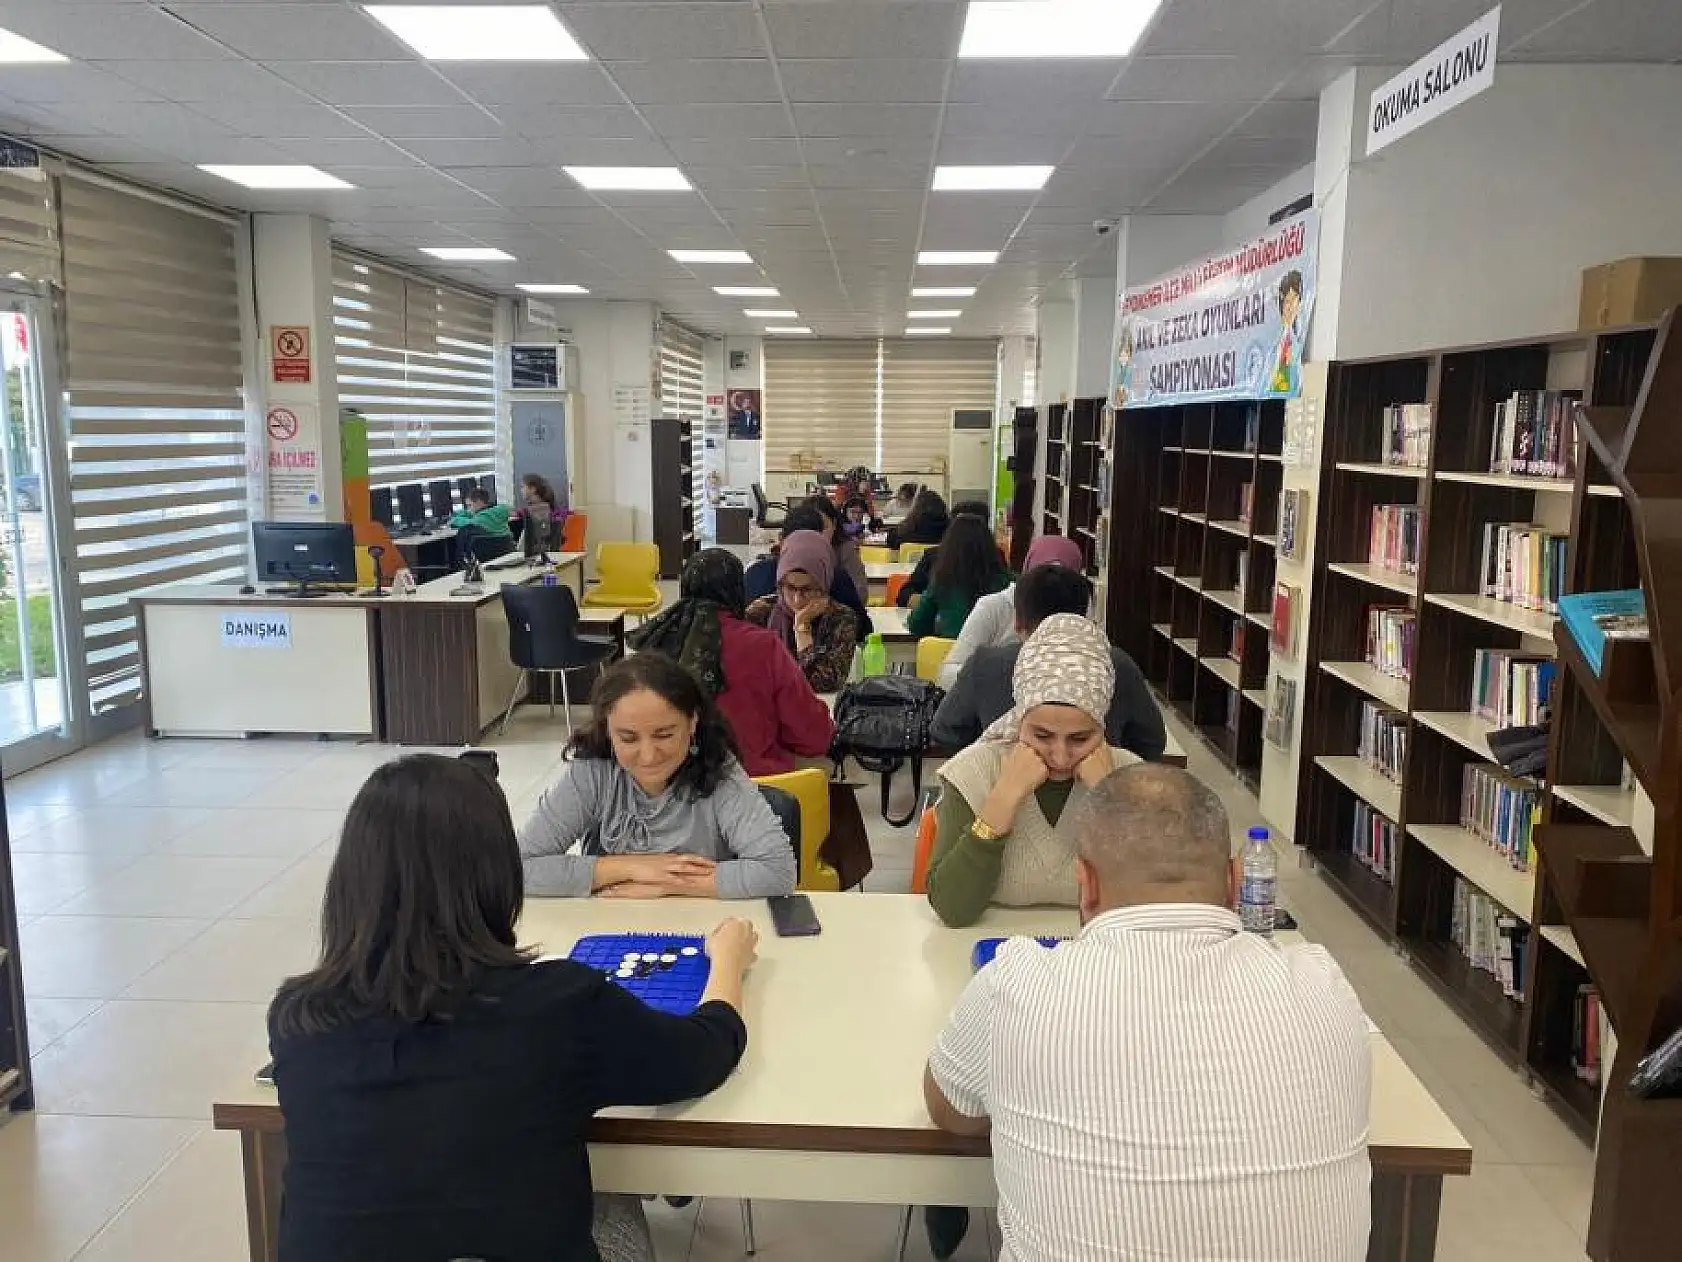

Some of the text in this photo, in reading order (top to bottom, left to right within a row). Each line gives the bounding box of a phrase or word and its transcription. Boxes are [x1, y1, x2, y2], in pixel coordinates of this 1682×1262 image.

[1373, 31, 1490, 133] OKUMA SALONU
[1236, 221, 1306, 275] MÜDÜRLÜĞÜ
[1172, 310, 1199, 343] ZEKA
[1201, 294, 1265, 337] OYUNLARI
[225, 621, 288, 640] DANIŞMA
